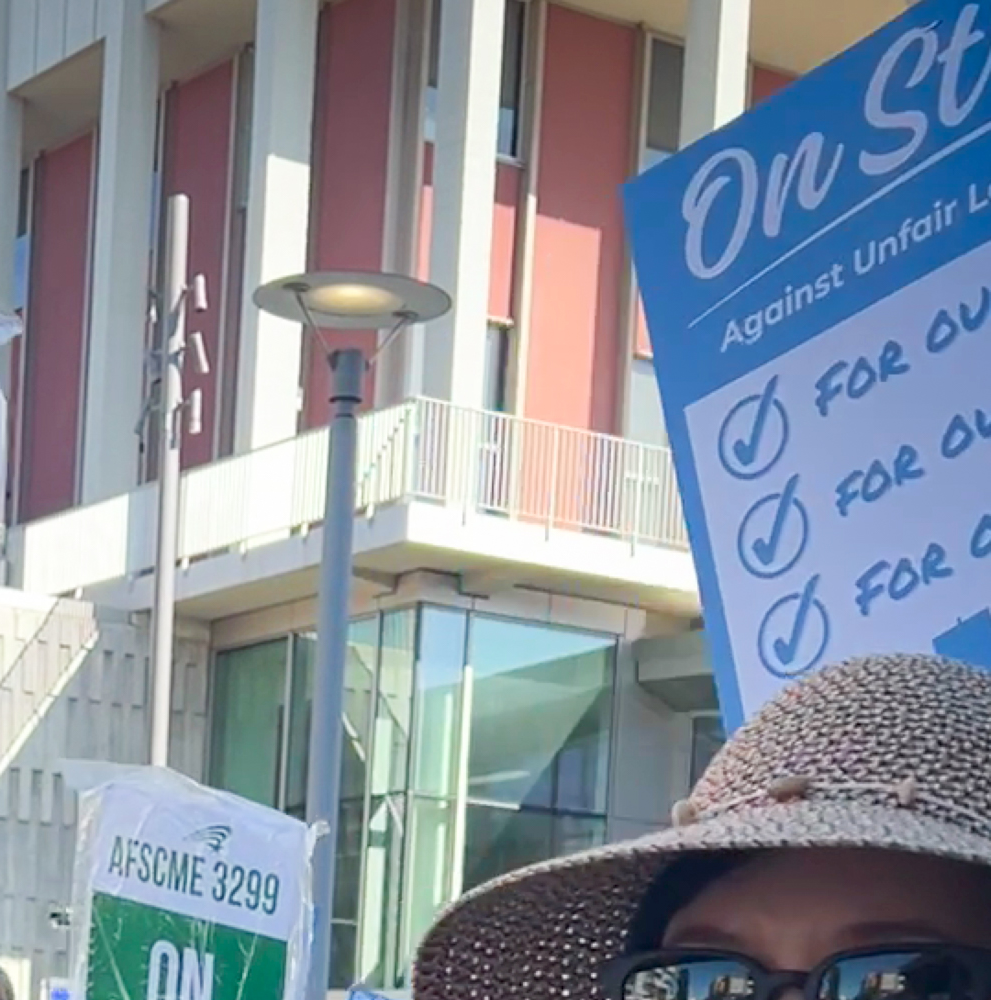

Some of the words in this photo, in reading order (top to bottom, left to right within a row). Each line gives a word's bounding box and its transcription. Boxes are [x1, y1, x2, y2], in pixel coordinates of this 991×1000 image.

[682, 132, 844, 279] On
[721, 264, 844, 352] Against
[854, 200, 957, 275] Unfair
[815, 340, 910, 416] FOR
[835, 445, 924, 516] FOR
[854, 542, 954, 616] FOR
[109, 836, 203, 897] AFSCME
[212, 861, 280, 915] 3299
